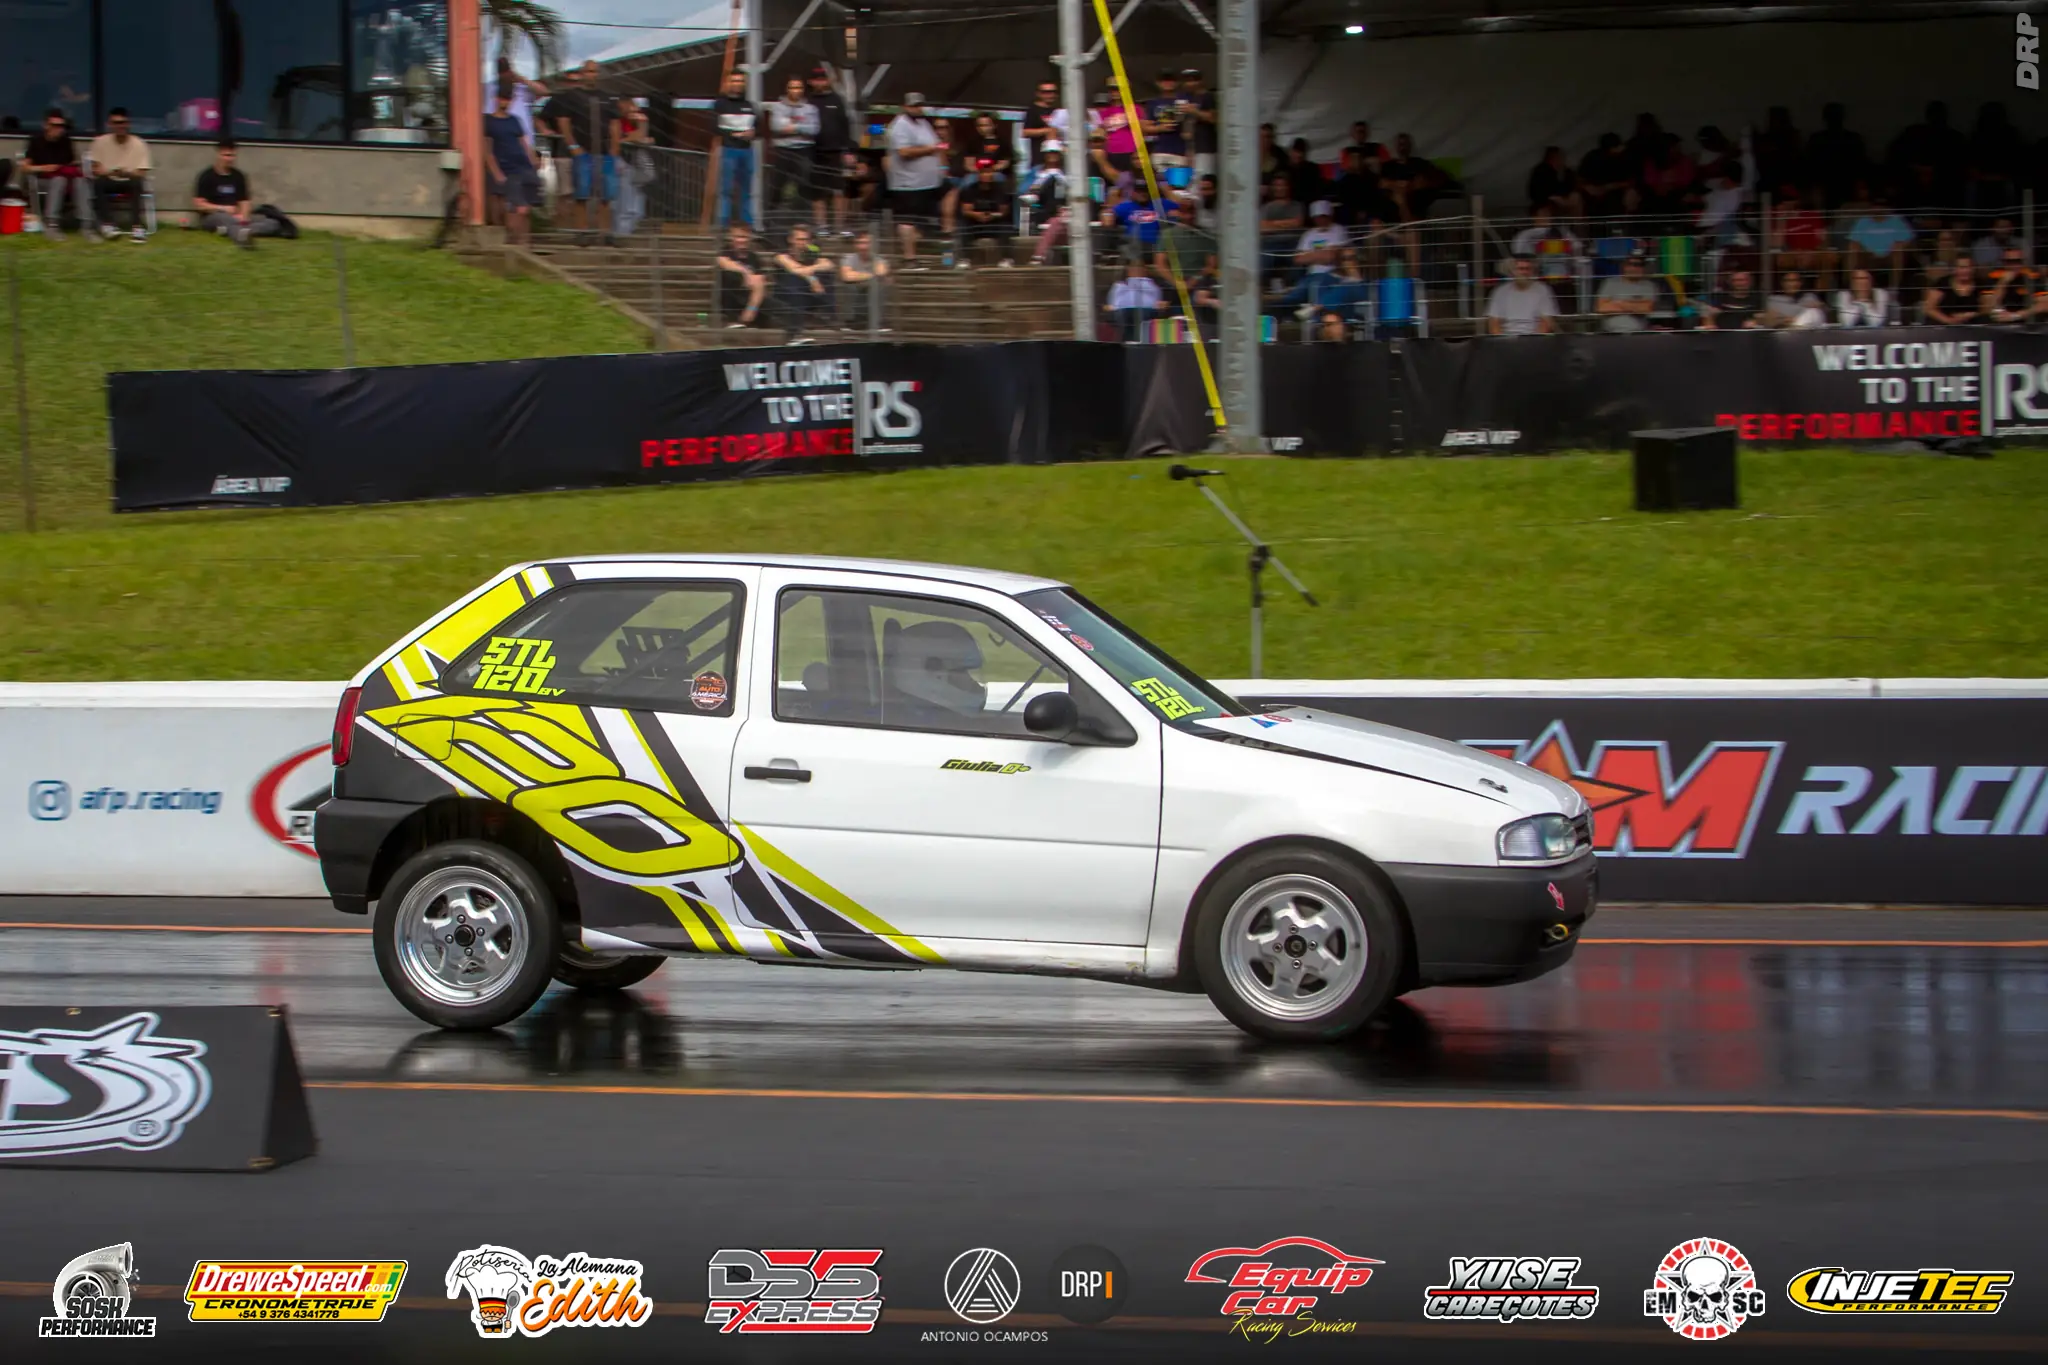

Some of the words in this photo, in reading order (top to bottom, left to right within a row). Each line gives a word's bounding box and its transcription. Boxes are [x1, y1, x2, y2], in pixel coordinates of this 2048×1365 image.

[1812, 341, 1980, 371] WELCOME
[723, 358, 853, 391] WELCOME
[1859, 377, 1907, 404] TO
[1911, 375, 1980, 402] THE
[762, 396, 804, 424] TO
[803, 393, 854, 421] THE
[862, 381, 922, 438] RS
[1715, 410, 1981, 440] PERFORMANCE
[640, 428, 854, 468] PERFORMANCE
[479, 636, 557, 669] STL
[472, 664, 550, 695] 120
[940, 759, 1003, 772] Giulia
[80, 787, 222, 814] afp.racing
[1777, 766, 2048, 835] RACI
